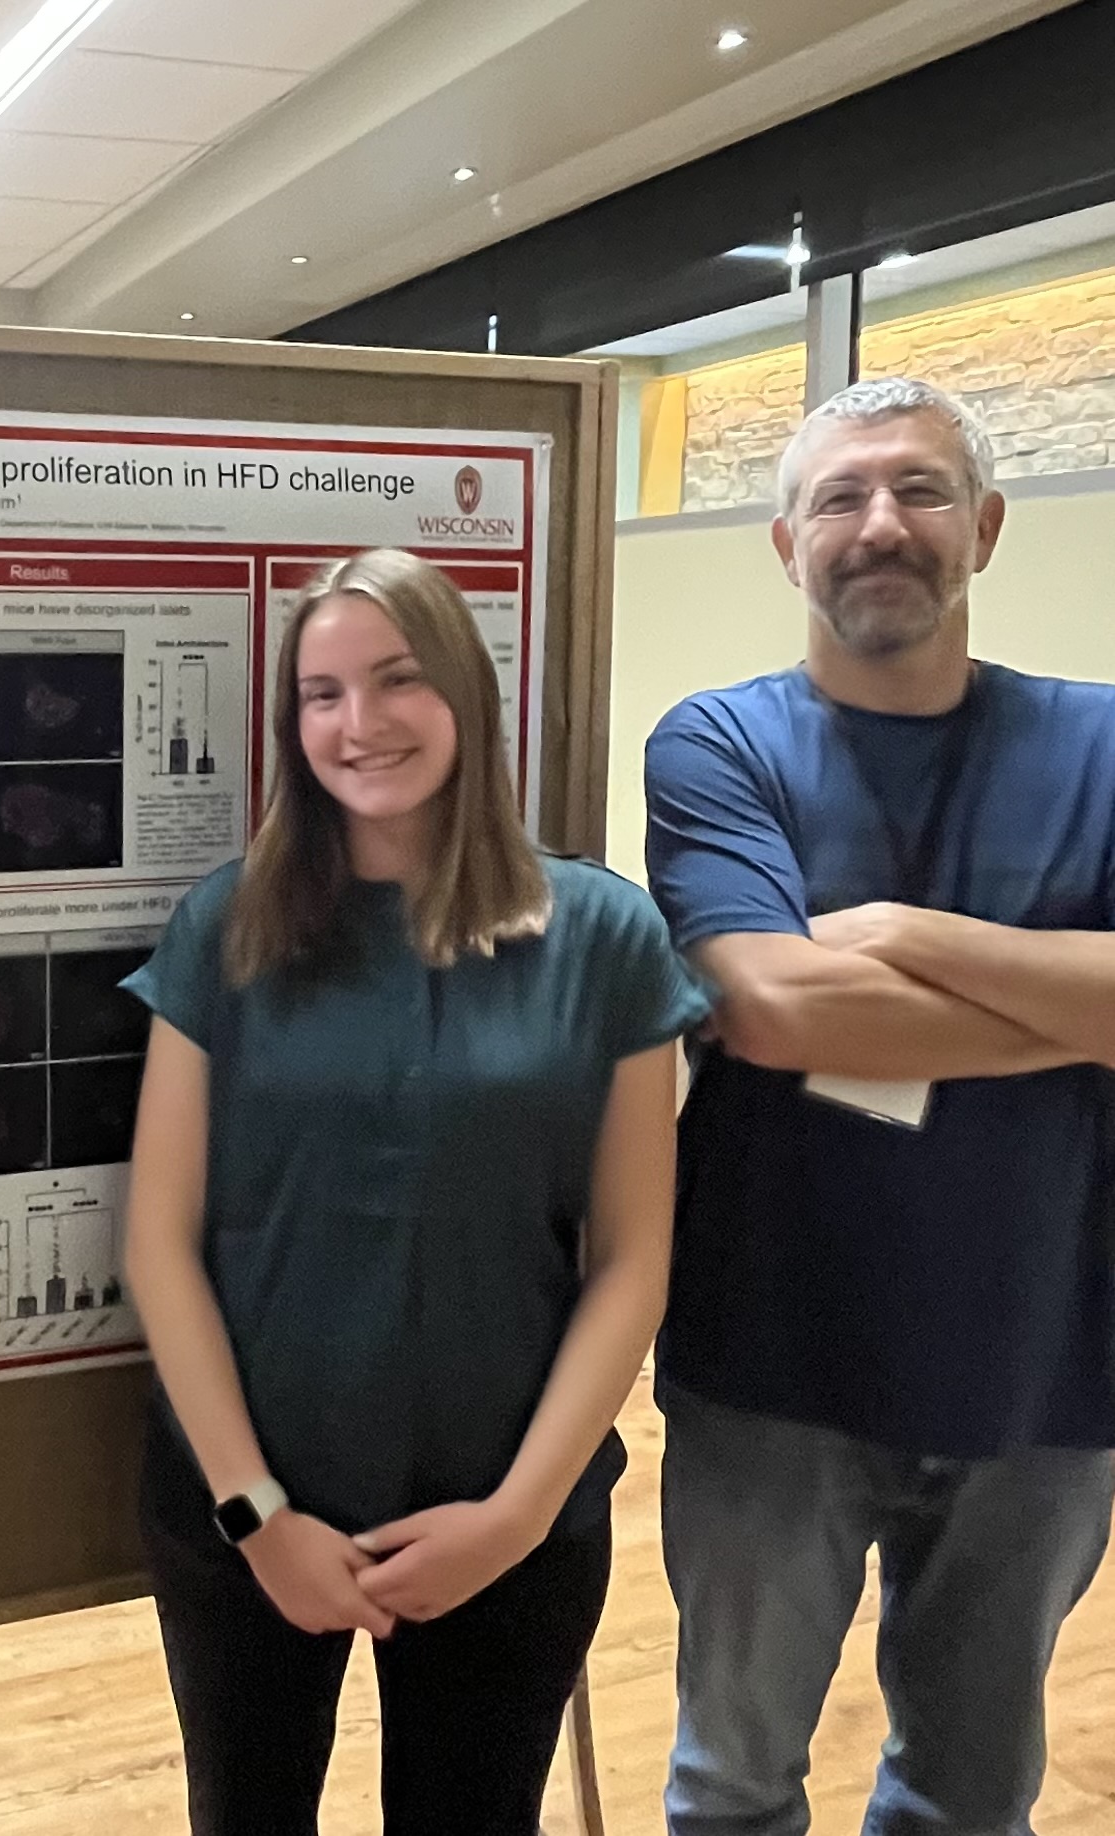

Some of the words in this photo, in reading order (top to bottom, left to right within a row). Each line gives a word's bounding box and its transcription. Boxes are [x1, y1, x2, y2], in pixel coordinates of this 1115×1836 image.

[1, 456, 173, 488] proliferation
[183, 461, 206, 487] in
[217, 462, 279, 489] HFD
[289, 466, 415, 500] challenge
[417, 515, 515, 536] WISCONSIN
[9, 563, 70, 581] Results
[2, 603, 35, 615] mice
[38, 603, 71, 615] have
[73, 603, 156, 619] disorganized
[65, 901, 98, 914] more
[142, 897, 172, 910] HFD
